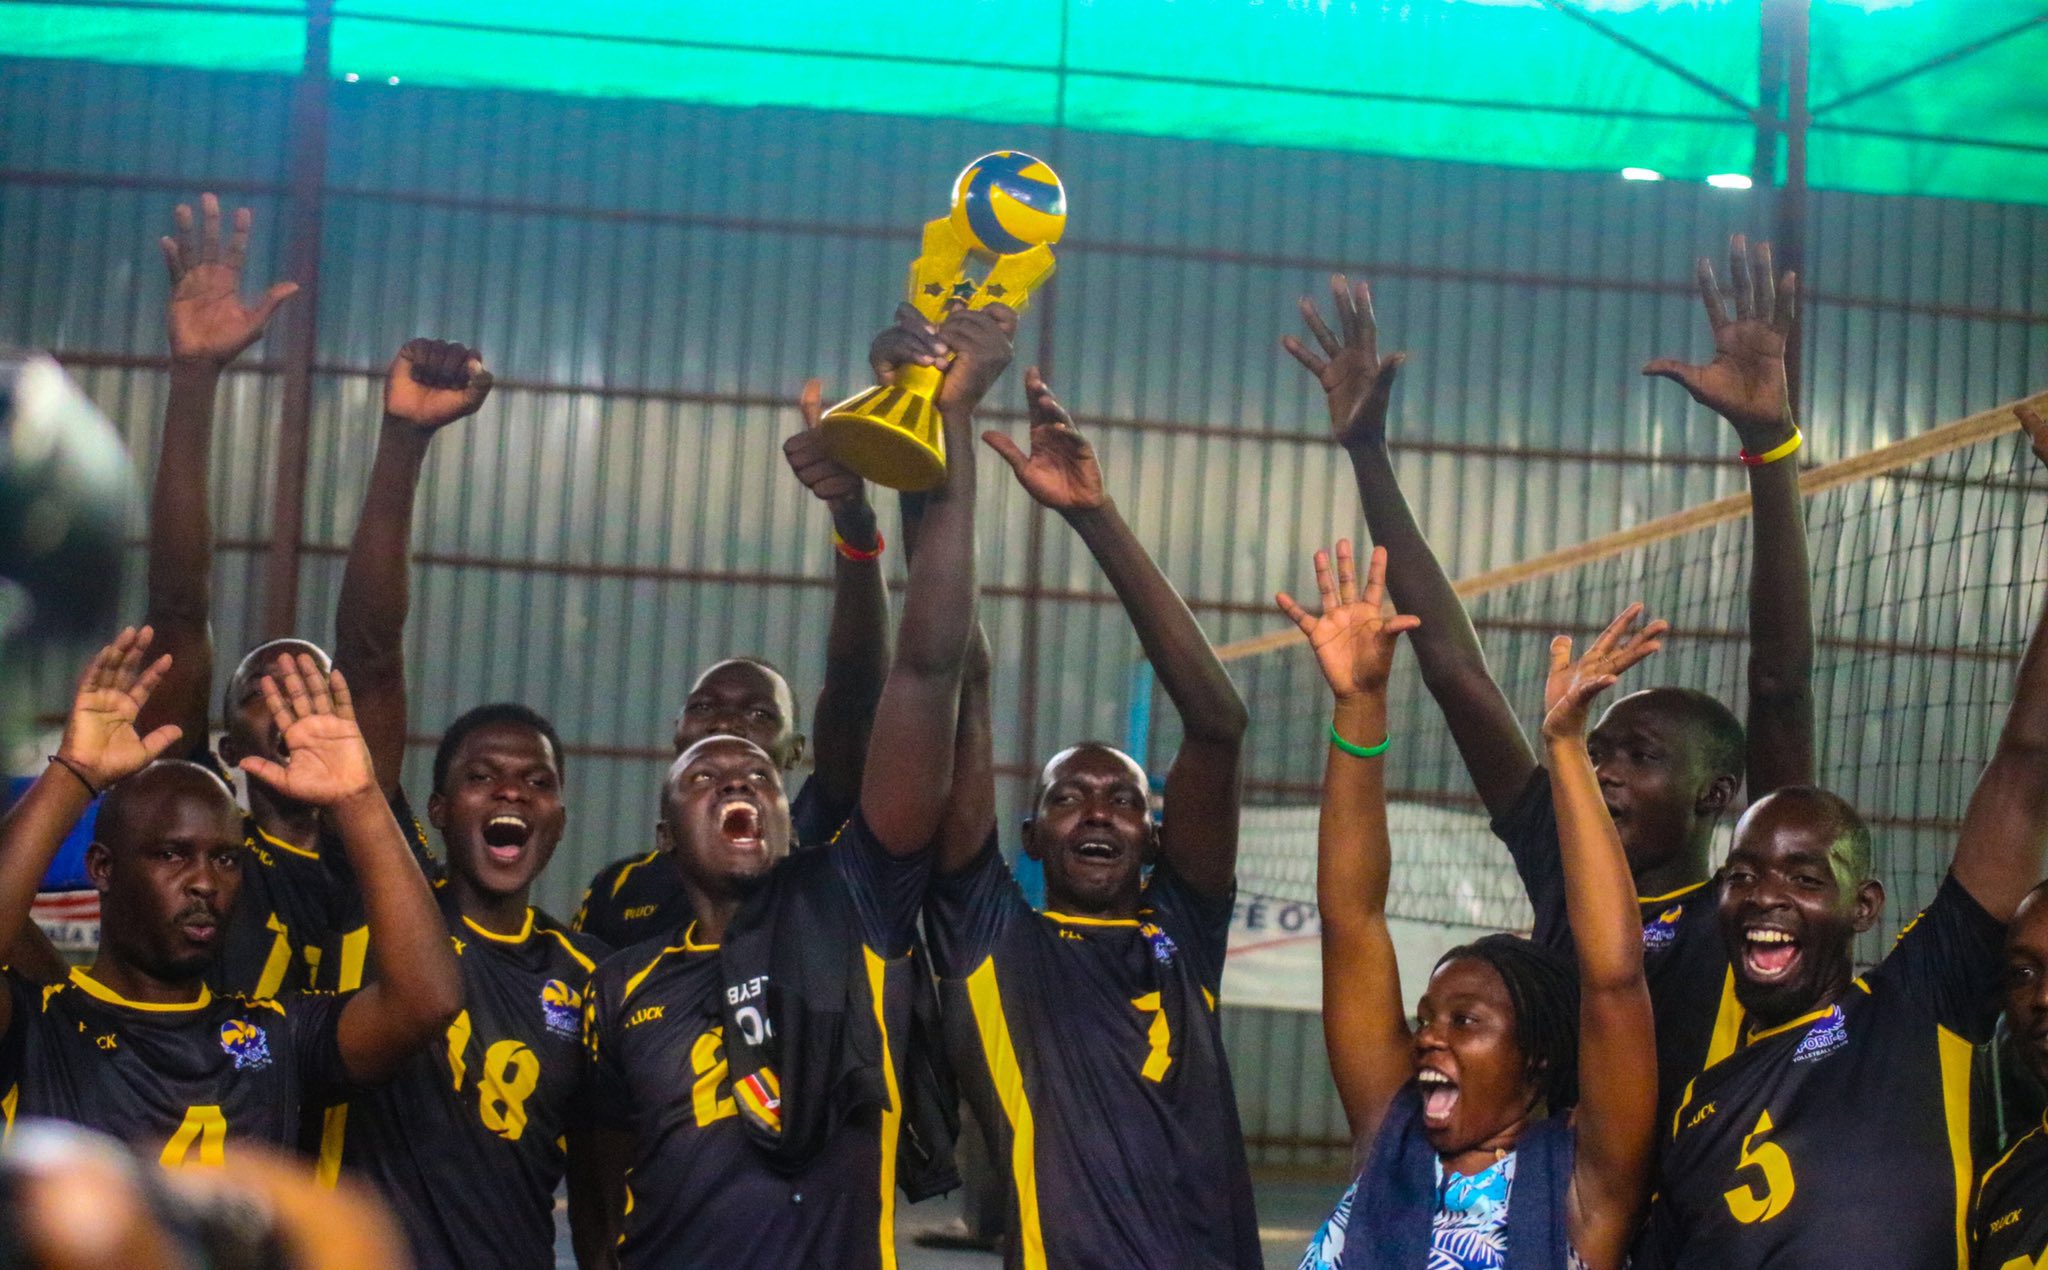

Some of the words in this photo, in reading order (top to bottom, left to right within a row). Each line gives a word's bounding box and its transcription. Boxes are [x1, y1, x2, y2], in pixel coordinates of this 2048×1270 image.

[625, 1005, 665, 1028] LUCK
[1794, 1029, 1848, 1056] PORT-S
[446, 1008, 540, 1140] 18
[1723, 1108, 1796, 1224] 5
